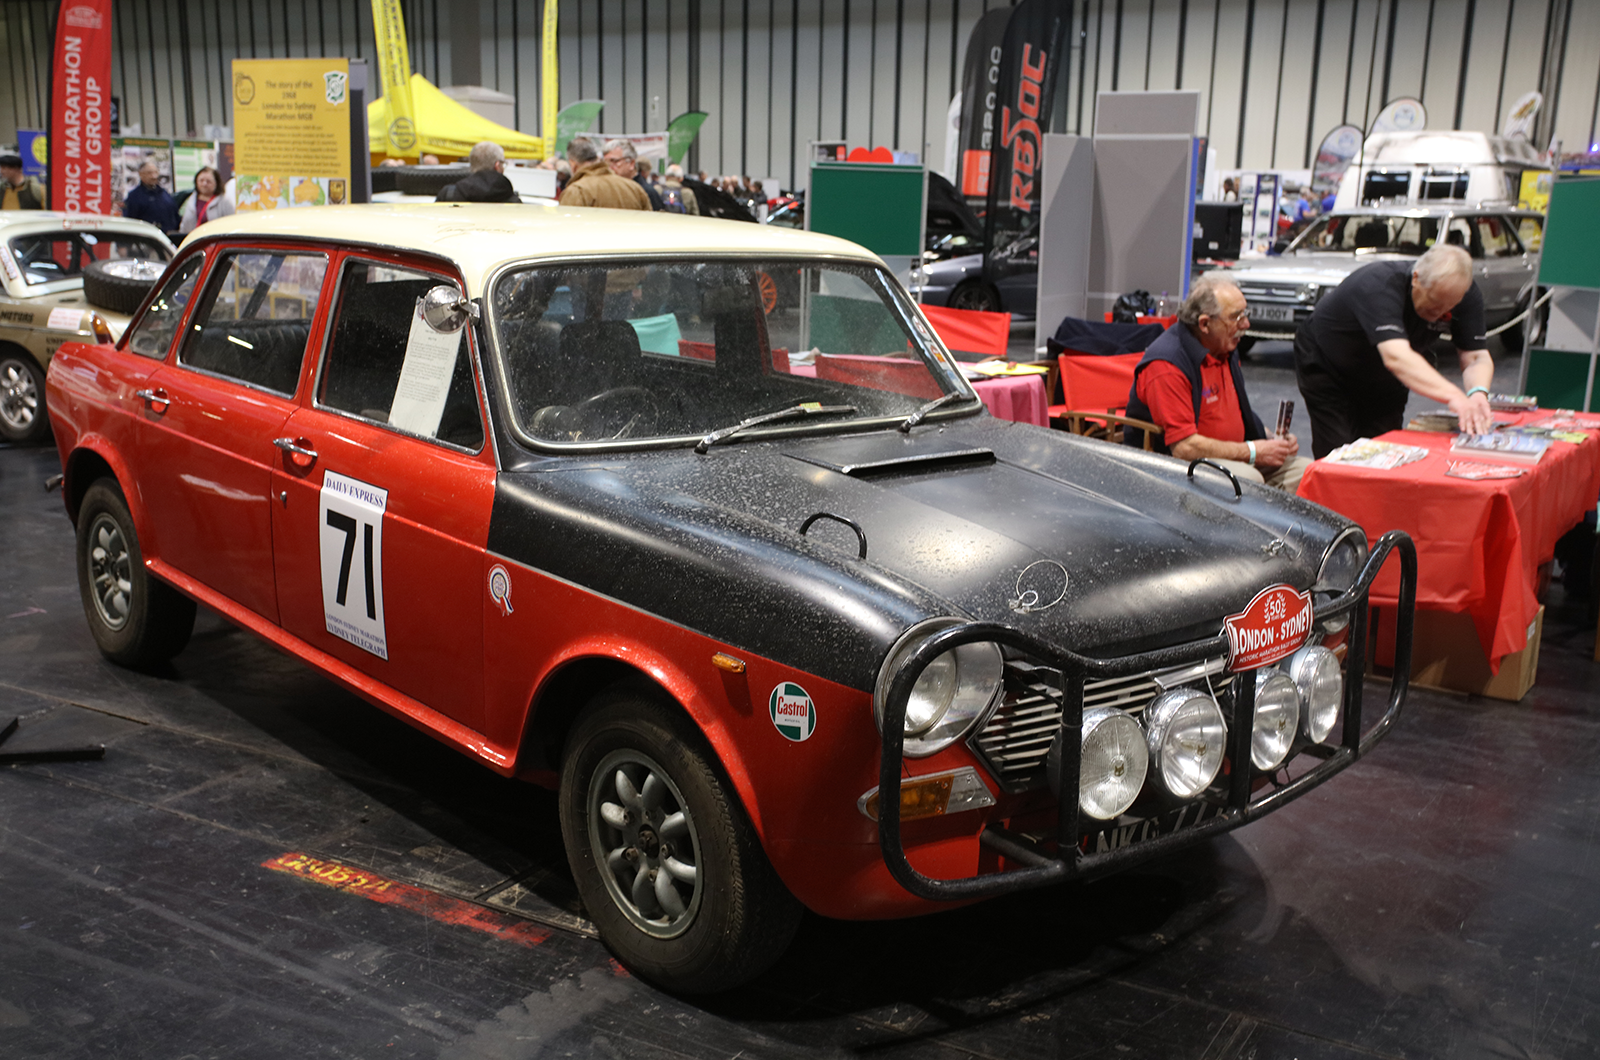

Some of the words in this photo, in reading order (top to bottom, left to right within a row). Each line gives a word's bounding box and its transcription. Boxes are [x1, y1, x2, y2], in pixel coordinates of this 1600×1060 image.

[64, 36, 82, 159] MARATHON
[265, 80, 276, 88] The
[279, 81, 293, 90] story
[295, 80, 302, 88] of
[303, 80, 313, 88] the
[85, 76, 102, 155] GROUP
[262, 102, 284, 110] London
[295, 102, 316, 111] Sydney
[266, 113, 296, 121] Marathon
[298, 113, 313, 121] MGB
[64, 163, 81, 216] ORIC
[85, 158, 102, 216] ALLY
[326, 478, 348, 494] DAILY
[349, 485, 384, 508] EXPRESS
[327, 508, 376, 621] 71
[1269, 599, 1281, 616] 50
[327, 622, 349, 640] SYDNEY
[350, 632, 386, 658] TELEGRAPH
[360, 628, 385, 645] MARATHON
[1232, 625, 1275, 656] LONDON
[1280, 602, 1310, 641] SYDNEY
[777, 696, 808, 718] Castrol
